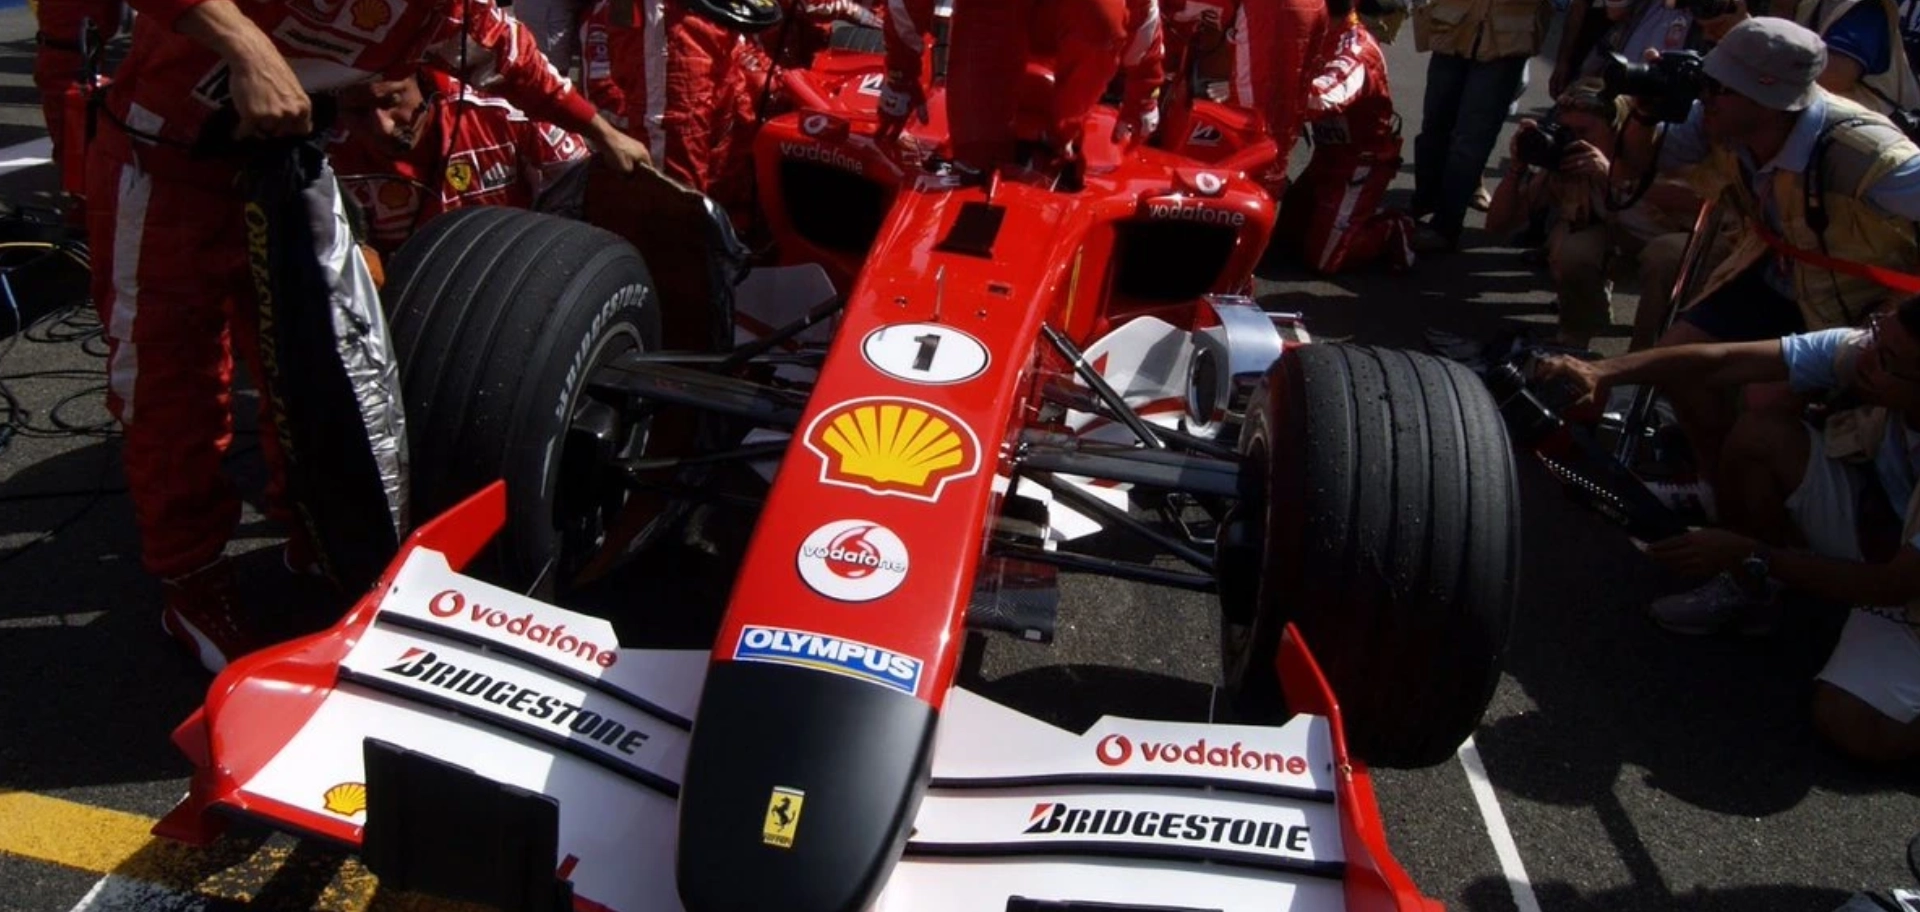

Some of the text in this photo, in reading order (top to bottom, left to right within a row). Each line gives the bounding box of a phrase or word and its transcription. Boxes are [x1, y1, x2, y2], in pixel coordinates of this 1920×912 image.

[780, 141, 863, 175] vodafone
[1149, 200, 1245, 226] vodafone
[911, 333, 942, 373] 1
[803, 545, 906, 574] vodafone
[471, 603, 618, 669] vodafone
[744, 629, 915, 680] OLYMPUS
[382, 646, 650, 756] BRIDGESTONE
[1140, 738, 1309, 775] vodafone
[1022, 802, 1311, 852] BRIDGESTONE
